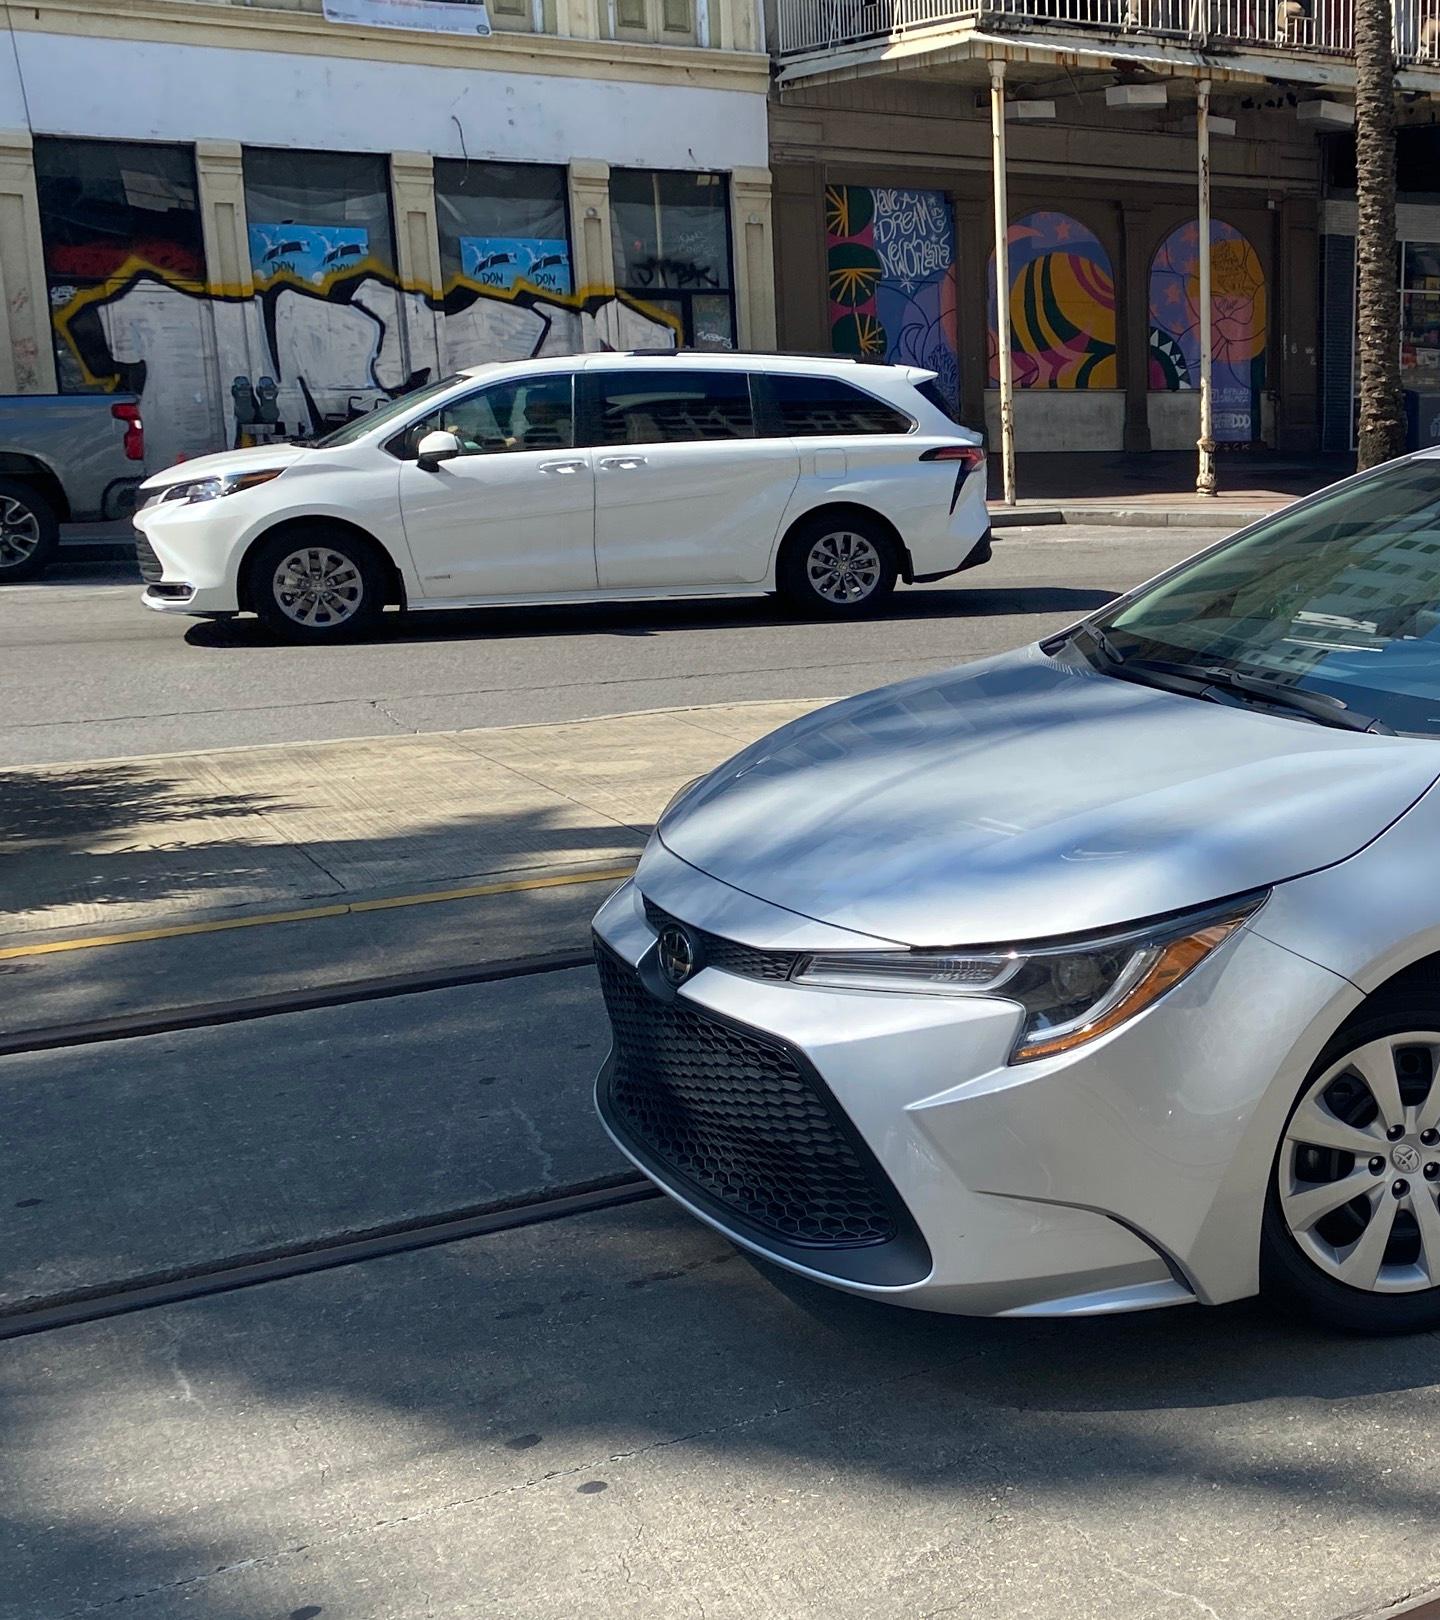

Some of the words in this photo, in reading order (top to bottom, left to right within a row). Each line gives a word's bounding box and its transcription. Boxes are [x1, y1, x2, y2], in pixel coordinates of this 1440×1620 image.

[272, 261, 296, 274] DON
[482, 272, 504, 286] DON
[535, 273, 556, 287] DON
